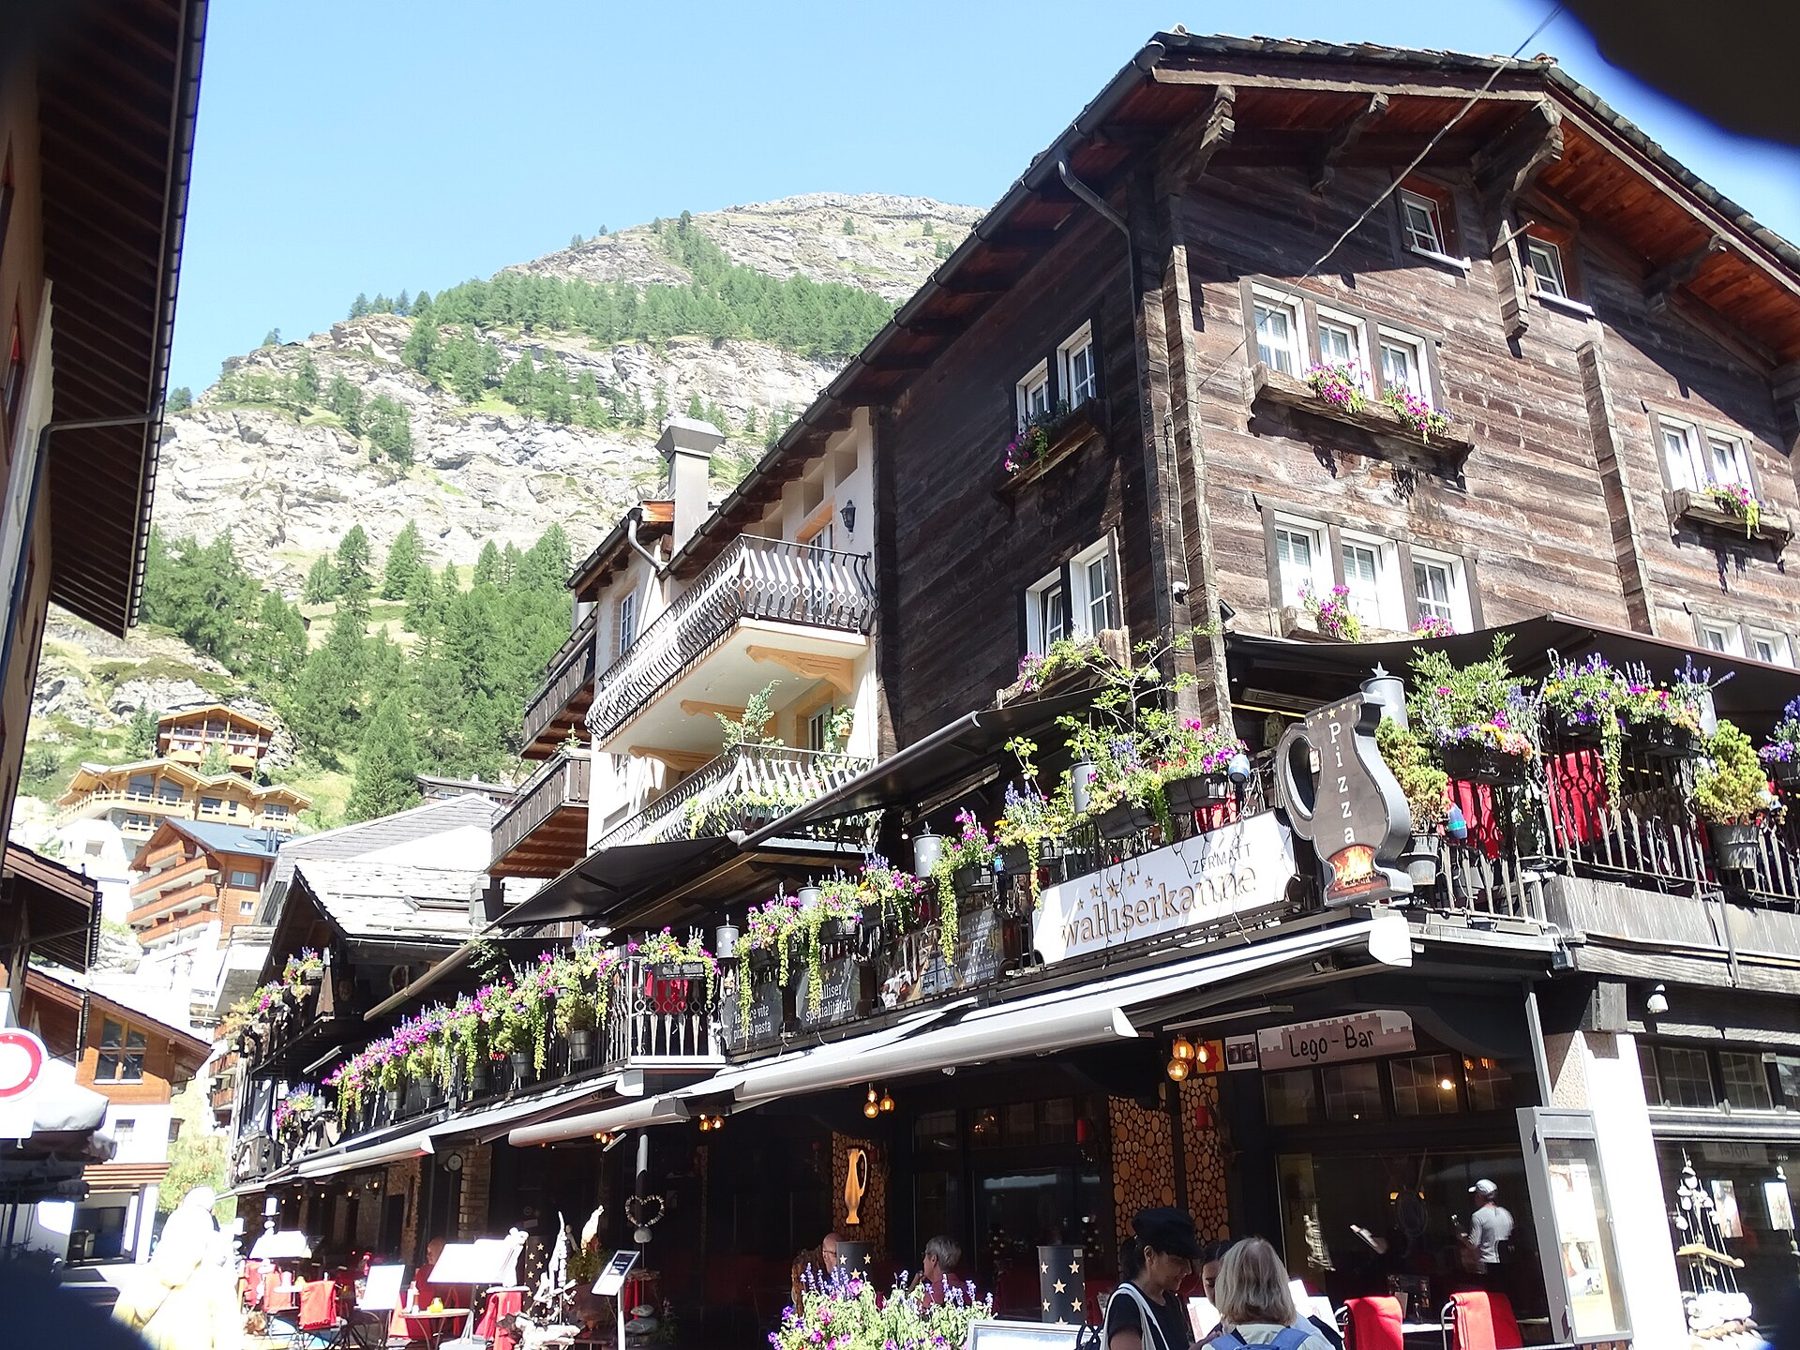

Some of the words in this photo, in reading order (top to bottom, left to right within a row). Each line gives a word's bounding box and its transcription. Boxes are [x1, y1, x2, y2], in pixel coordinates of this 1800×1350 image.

[1328, 721, 1356, 844] Pizza
[1193, 843, 1251, 875] ZERMATT
[1062, 866, 1256, 948] walliserkanne
[805, 998, 852, 1024] speialitäten
[755, 1020, 772, 1038] pasta
